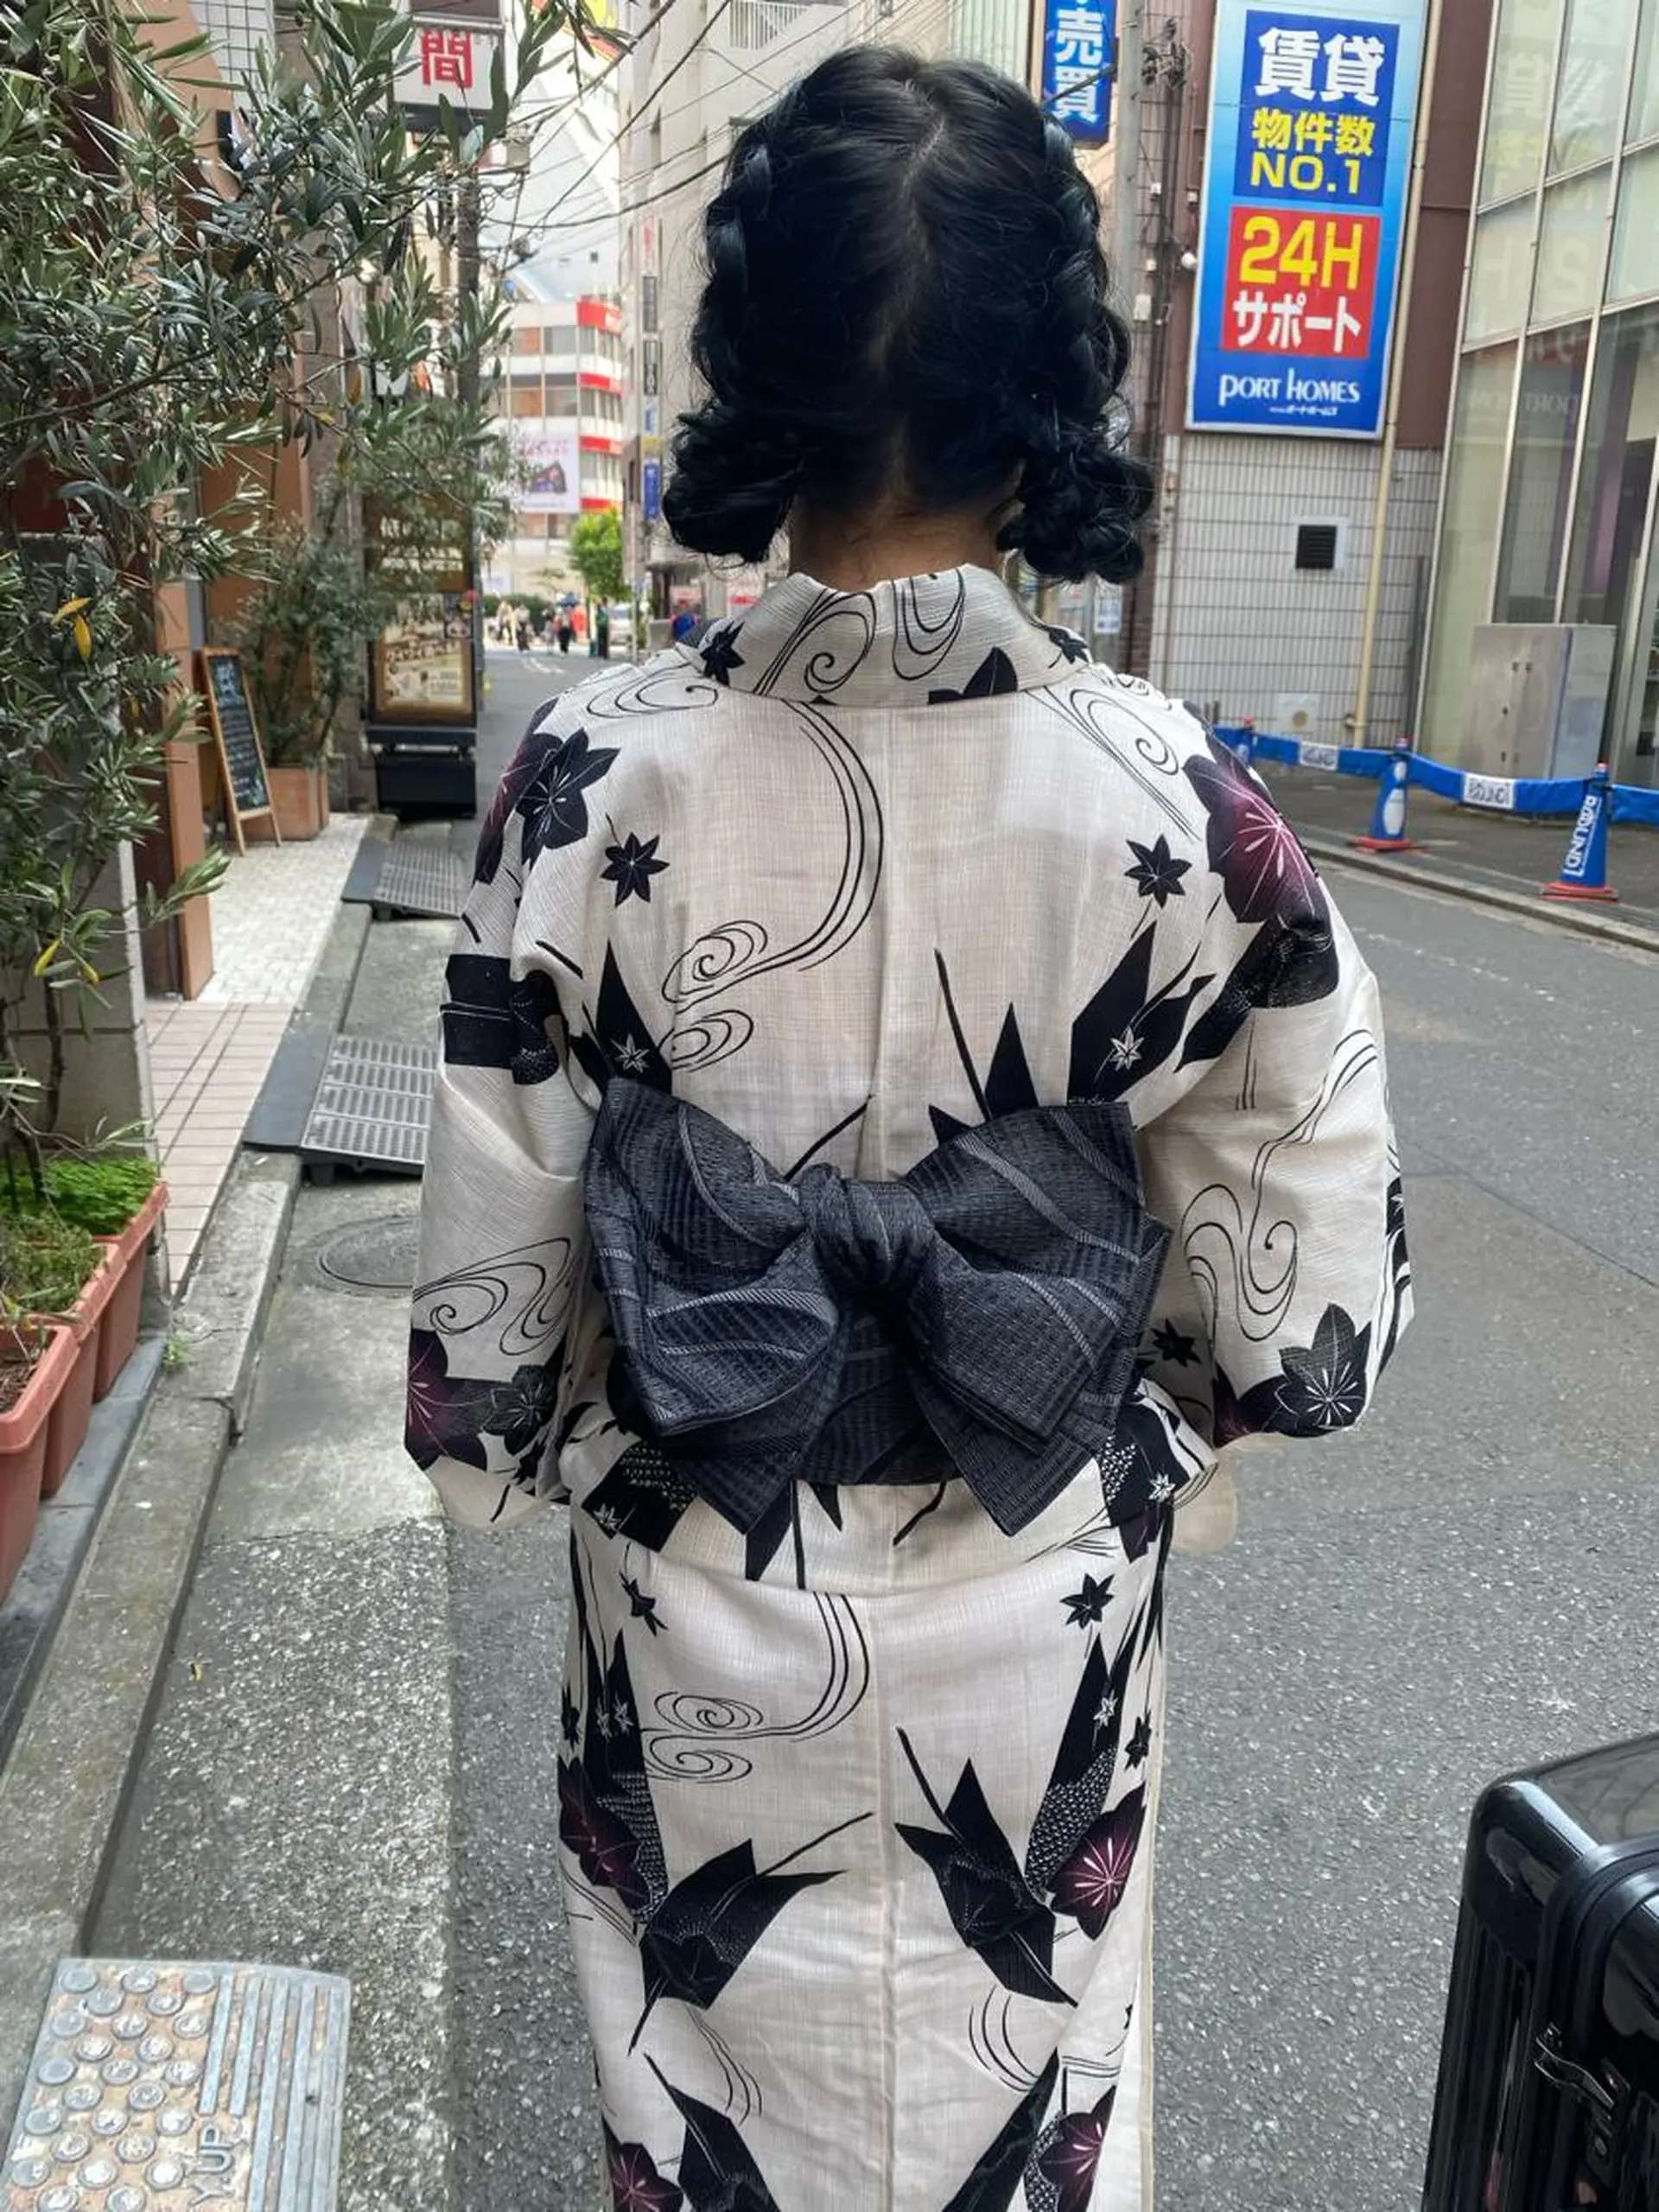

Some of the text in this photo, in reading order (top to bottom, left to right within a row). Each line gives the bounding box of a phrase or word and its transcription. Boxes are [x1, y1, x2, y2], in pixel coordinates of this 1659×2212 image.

[422, 29, 474, 88] 間
[1054, 7, 1104, 123] 売買
[1255, 27, 1385, 107] 賃貸
[1252, 106, 1376, 156] 物件数
[1249, 150, 1362, 194] NO.1
[1240, 215, 1363, 289] 24H
[1232, 289, 1362, 353] サポート
[1218, 373, 1281, 407] PORT
